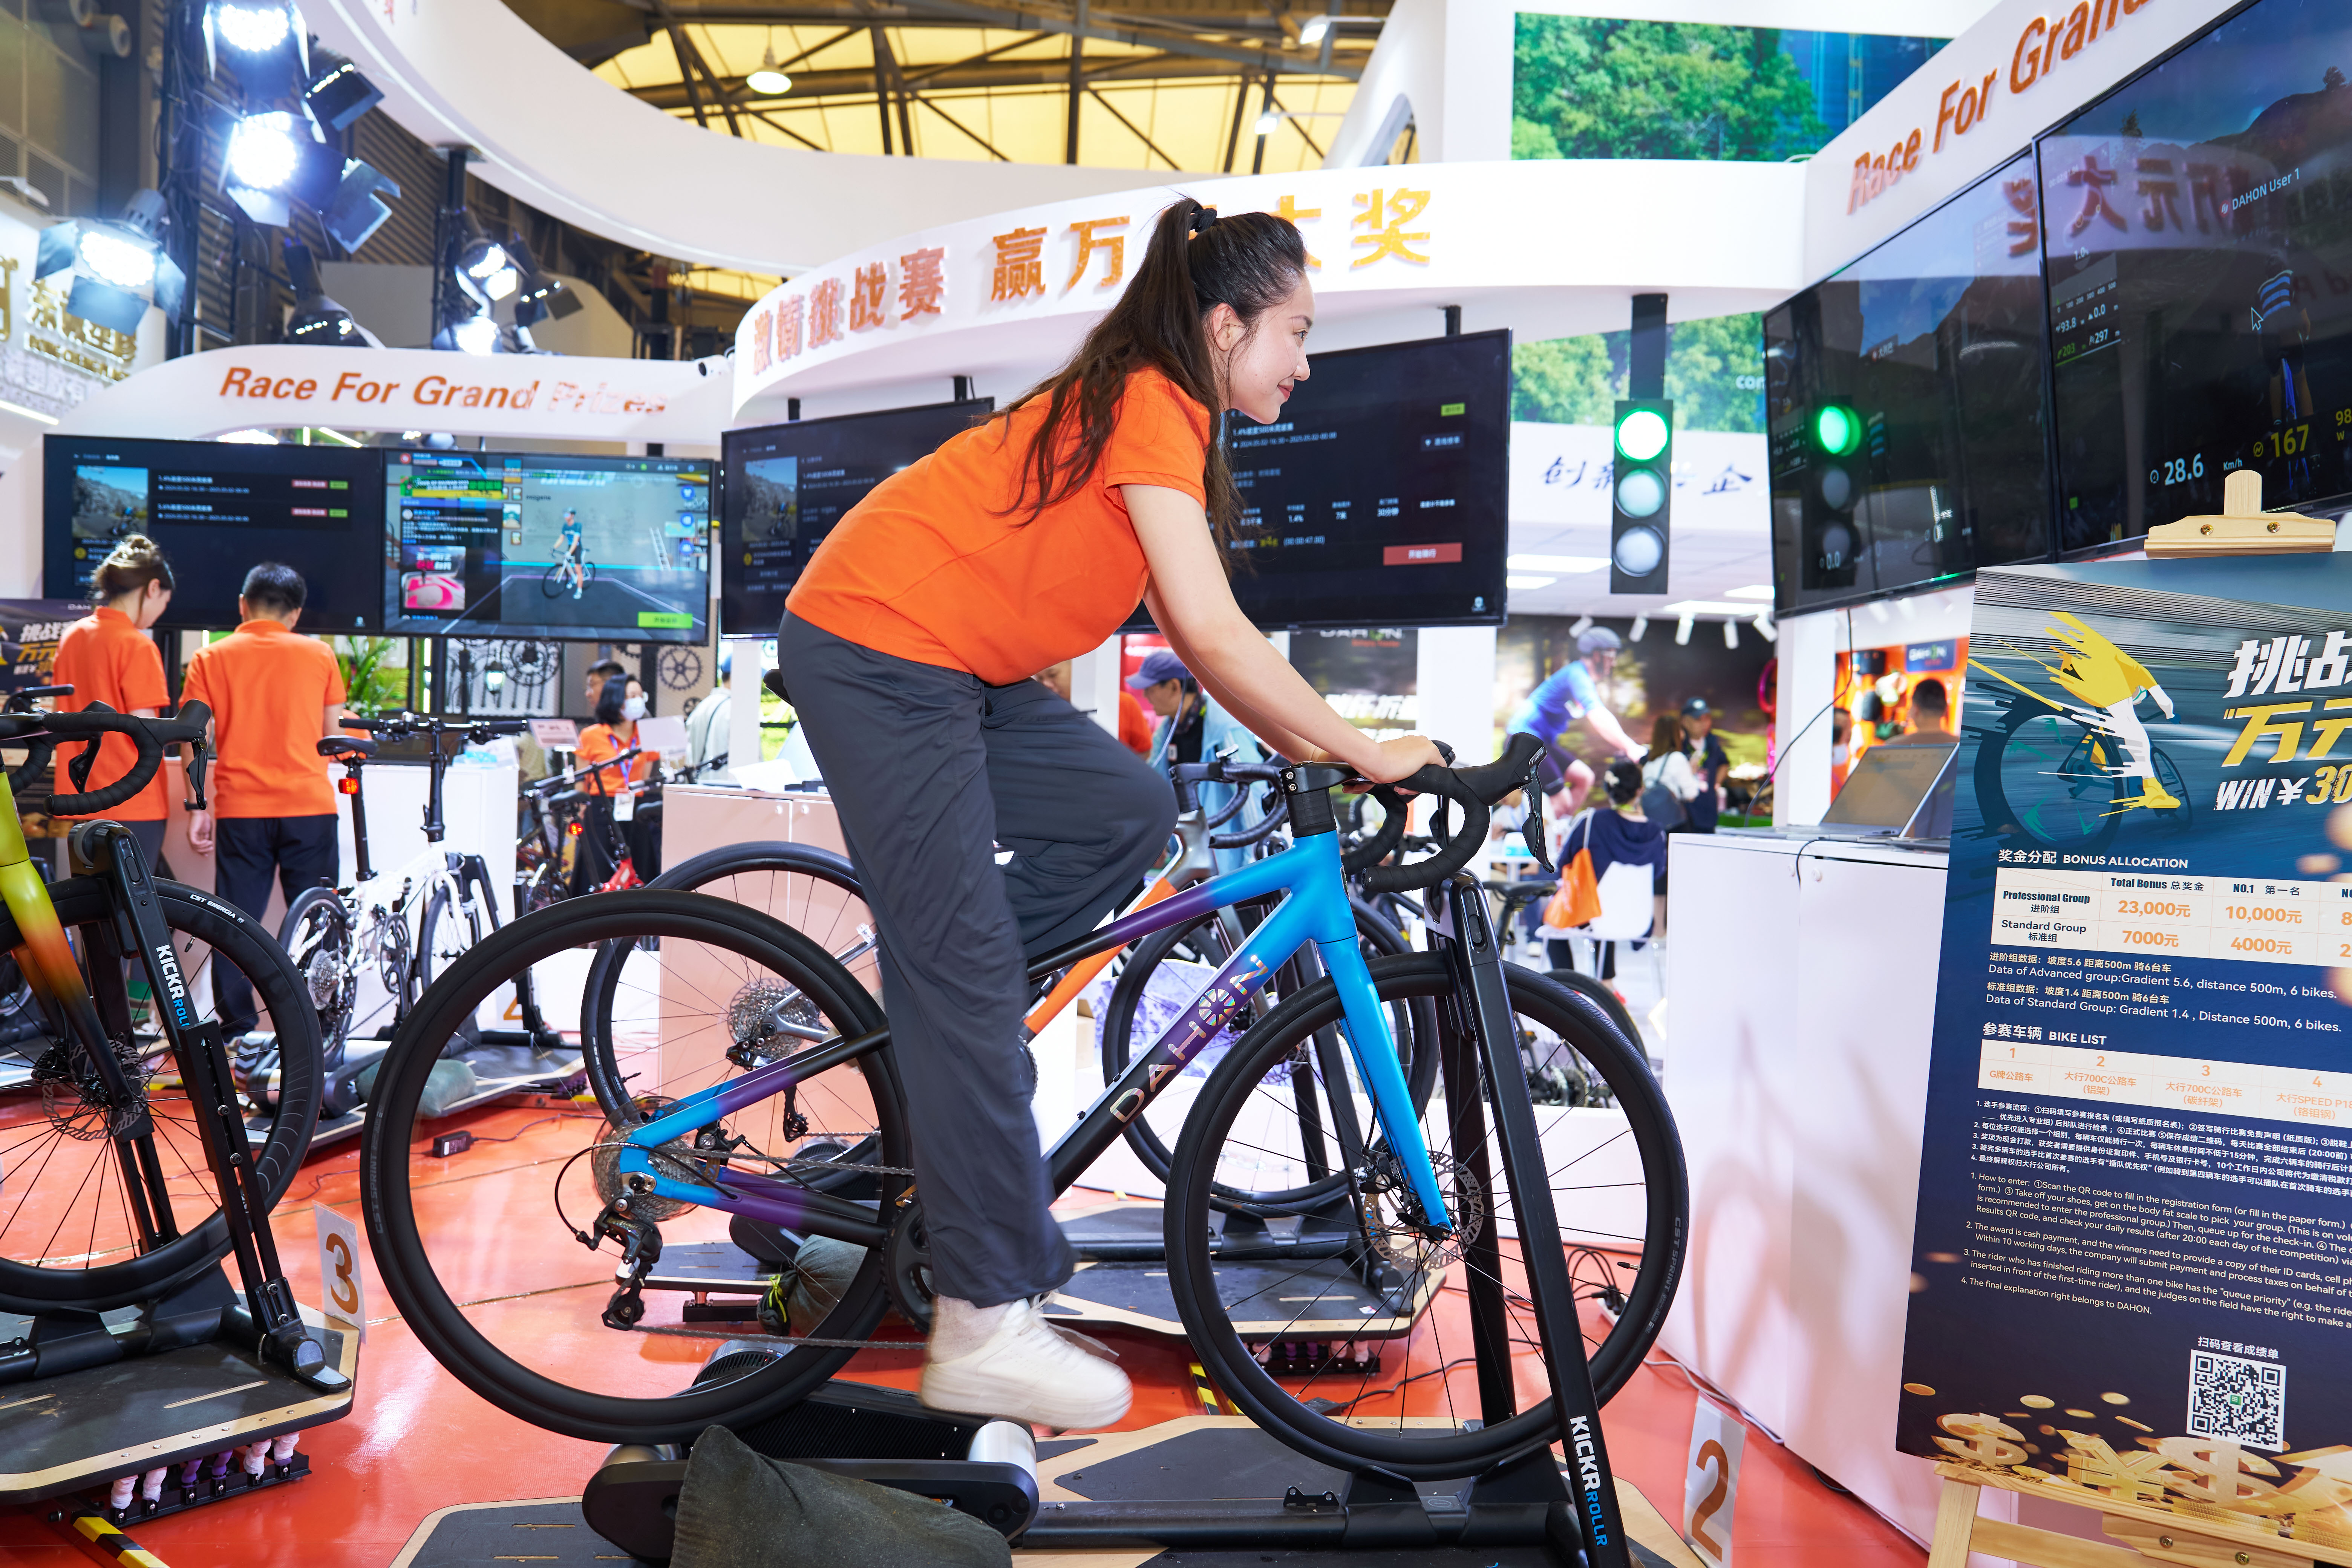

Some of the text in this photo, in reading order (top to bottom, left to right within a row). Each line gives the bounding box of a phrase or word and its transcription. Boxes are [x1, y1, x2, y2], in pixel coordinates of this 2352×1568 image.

[1847, 127, 1922, 215] Race
[1932, 68, 1997, 153] For
[2232, 168, 2300, 210] DAHON User 1
[2094, 303, 2106, 318] 0.0
[2061, 317, 2076, 332] 93.8
[2095, 328, 2109, 343] 297
[2063, 342, 2075, 357] 203
[220, 368, 667, 415] Race For Grand Prizes
[2271, 424, 2309, 458] 167
[2164, 453, 2242, 486] 28.6 Km/h
[1531, 750, 1544, 764] Tiagra
[2214, 778, 2276, 810] WIN
[1998, 849, 2188, 868] 奖金分配 BONUS ALLOCATION
[2111, 878, 2204, 891] Total Bonus 总奖金
[2233, 884, 2299, 896] NO.1 第一名
[2003, 891, 2090, 904] Professional Group
[190, 894, 236, 919] CST ENERGIA
[2031, 904, 2059, 913] 进阶组
[2118, 900, 2190, 917] 23,000元
[2226, 906, 2302, 923] 10,000元
[2002, 920, 2086, 934] Standard Group
[2029, 933, 2057, 942] 标准组
[2122, 931, 2179, 947] 7000元
[2231, 937, 2292, 954] 4000元
[1989, 965, 2337, 998] Data of Advanced group:Gradient 5.6, distance 500m, 6 bikes.
[1986, 994, 2341, 1032] Data of Standard Group: Gradient 1.4 Distance 500m, 6 bikes.
[1109, 954, 1269, 1123] DAHON
[1983, 1022, 2107, 1044] 参赛车辆 BIKE LIST
[2009, 1048, 2015, 1058] 1
[2097, 1056, 2105, 1067] 2
[1990, 1070, 2033, 1081] G牌公路车
[2202, 1065, 2210, 1076] 3
[2065, 1072, 2136, 1086] 大行700C公路车
[2313, 1076, 2322, 1087] 4
[2084, 1085, 2110, 1096] (铝架)
[2166, 1082, 2242, 1098] 大行700C公路车
[2184, 1095, 2222, 1107] (碳纤架)
[2277, 1093, 2332, 1106] 大行SPEED
[1977, 1205, 2003, 1215] Results
[2020, 1213, 2040, 1221] code,
[2060, 1217, 2082, 1226] check
[2105, 1223, 2125, 1234] daily
[2127, 1228, 2154, 1236] results
[2157, 1230, 2180, 1240] (after
[2183, 1234, 2207, 1244] 20:00
[2232, 1242, 2248, 1252] day
[2262, 1246, 2277, 1254] the
[2280, 1250, 2338, 1264] competition)
[325, 1233, 358, 1314] 3
[1664, 1250, 1678, 1292] SPRINT
[1970, 1278, 1983, 1286] The
[1986, 1280, 2001, 1289] final
[2004, 1285, 2049, 1297] explanation
[2051, 1292, 2070, 1301] right
[2072, 1294, 2104, 1307] belongs
[2118, 1302, 2151, 1314] DAHON.
[2198, 1336, 2278, 1359] 扫码查看成绩单
[1691, 1439, 1729, 1562] 2
